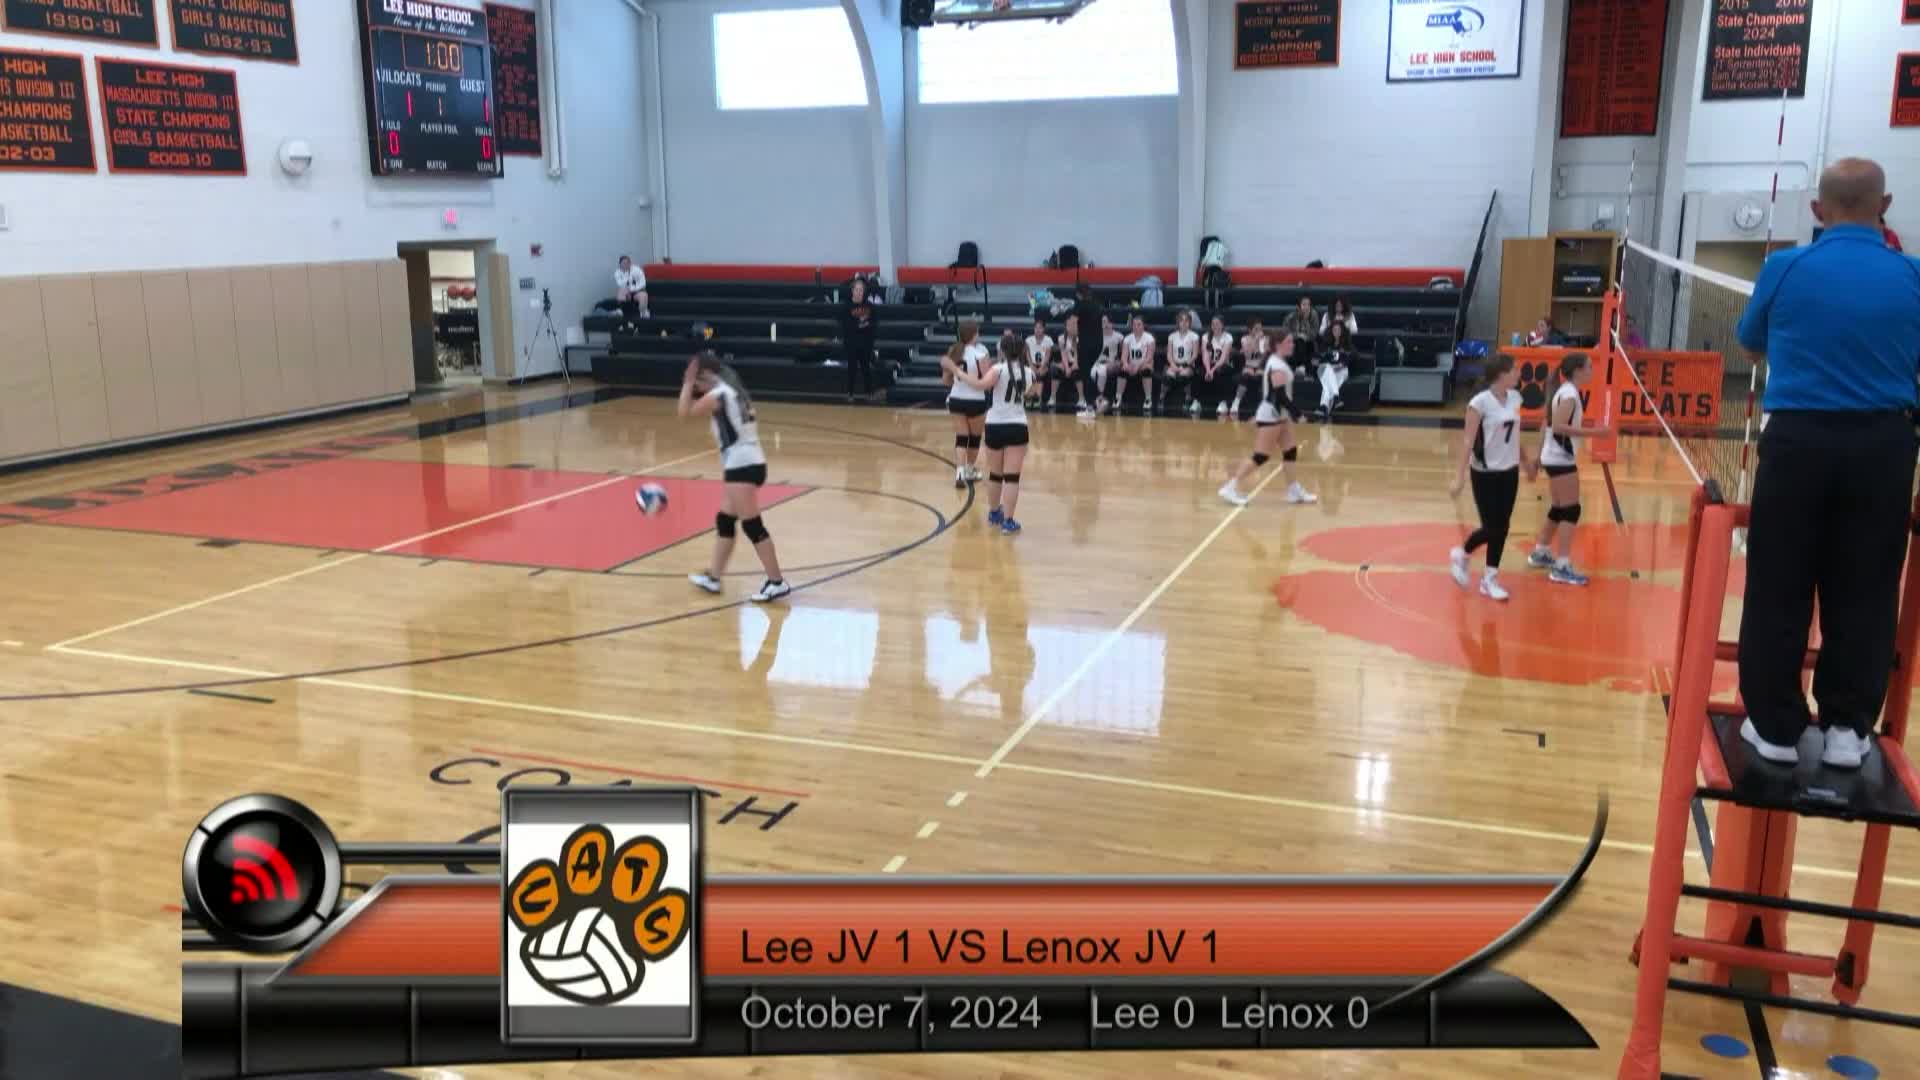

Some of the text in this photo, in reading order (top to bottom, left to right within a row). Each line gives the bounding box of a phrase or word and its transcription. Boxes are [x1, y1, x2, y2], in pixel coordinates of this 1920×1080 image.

[45, 10, 120, 33] 1990-91
[181, 8, 287, 38] GIRLS BASKETBALL
[383, 0, 475, 26] LEE HIGH SCHOOL
[1428, 15, 1457, 25] MIAA
[1717, 11, 1805, 29] State Champions
[203, 32, 272, 53] 1992-93
[1743, 27, 1776, 41] 2024
[426, 41, 461, 71] 1:00
[1410, 48, 1497, 65] LEE HIGH SCHOOL
[1714, 42, 1802, 59] State Individuals
[4, 58, 47, 75] HIGH
[376, 67, 422, 87] WILDCATS
[136, 68, 205, 88] LEE HIGH
[460, 79, 486, 93] GUEST
[16, 79, 54, 97] DIVISION
[59, 81, 75, 100] III
[106, 85, 181, 107] MASSACHUSETTS
[184, 91, 217, 110] DIVISION
[116, 107, 231, 129] STATE CHAMPIONS
[420, 121, 443, 135] PLAYER
[113, 127, 239, 150] GIRLS BASKETBALL
[389, 131, 400, 156] 0
[482, 134, 491, 159] 0
[426, 160, 448, 171] MATCH
[1632, 360, 1676, 386] EE
[1578, 390, 1713, 417] WDCATS
[1503, 419, 1515, 444] 7
[429, 757, 799, 831] COH
